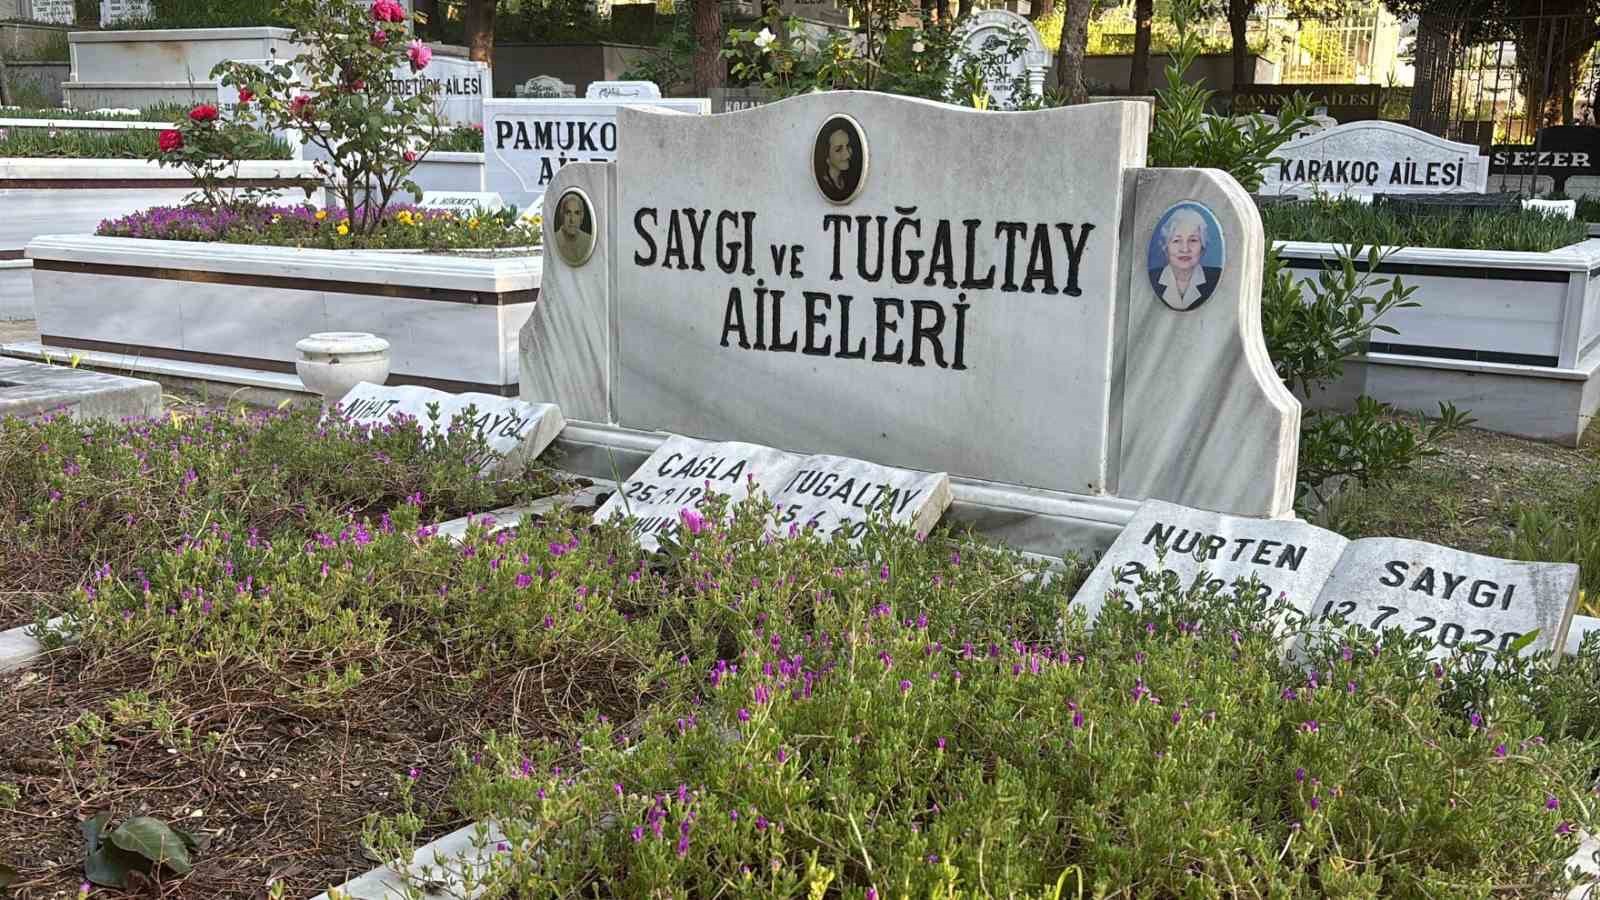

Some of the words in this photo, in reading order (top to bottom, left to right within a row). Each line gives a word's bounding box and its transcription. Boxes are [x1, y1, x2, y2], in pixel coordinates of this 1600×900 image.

[446, 74, 482, 95] AİLESİ
[1279, 159, 1379, 186] KARAKOÇ
[1389, 156, 1465, 187] AİLESİ
[1494, 151, 1591, 167] SEZER
[633, 206, 757, 276] SAYGI
[770, 244, 805, 279] VE
[823, 205, 1096, 297] TUĞALTAY
[719, 278, 971, 371] AİLELERİ
[1142, 522, 1308, 572] NURTEN
[1378, 560, 1518, 611] SAYGI
